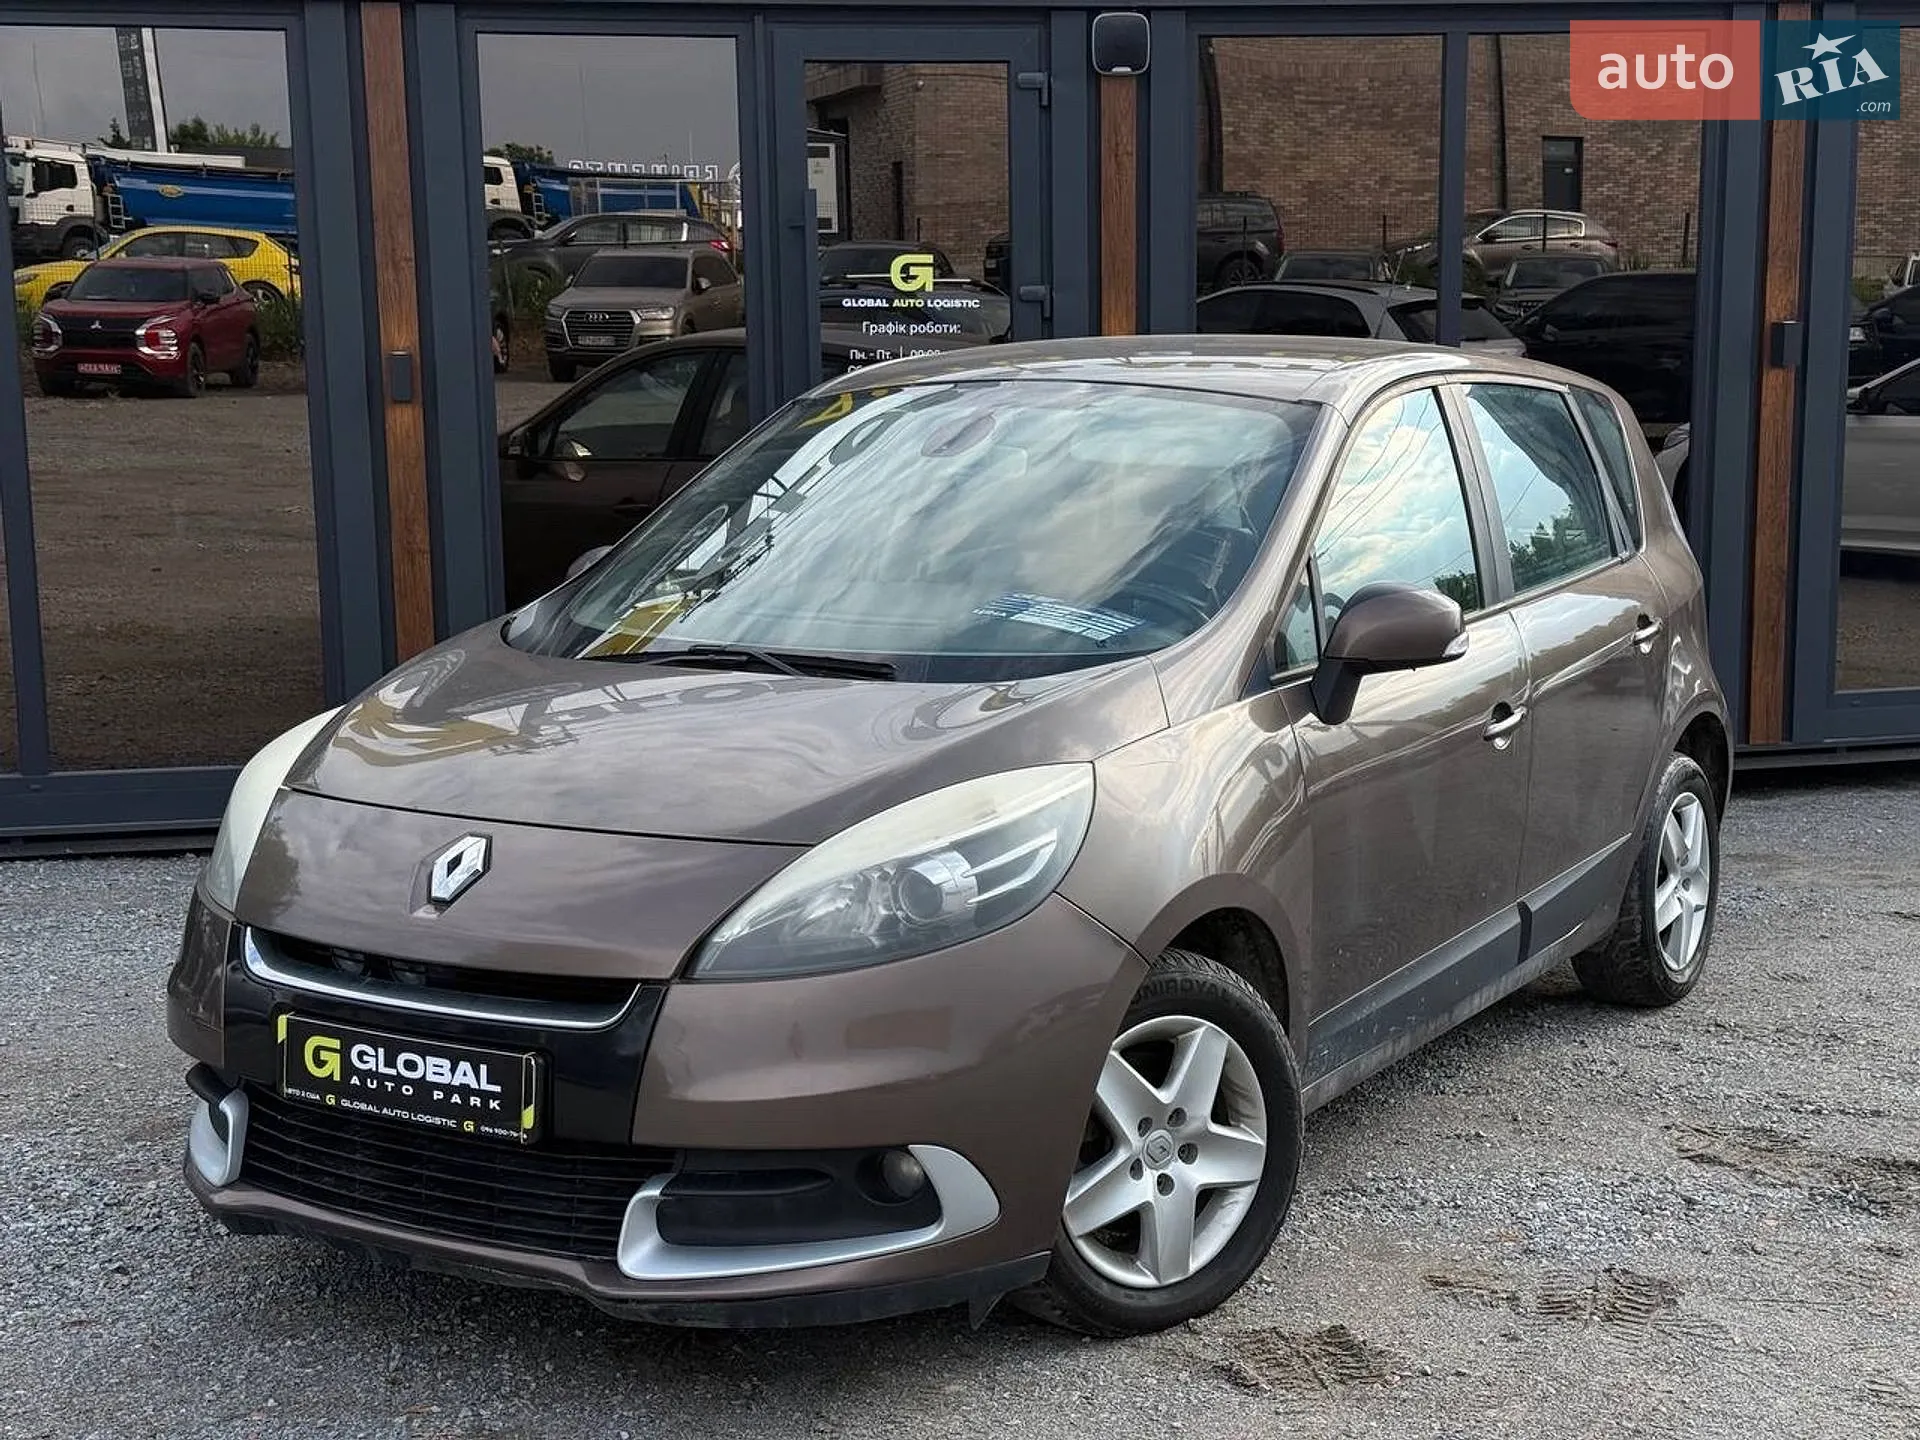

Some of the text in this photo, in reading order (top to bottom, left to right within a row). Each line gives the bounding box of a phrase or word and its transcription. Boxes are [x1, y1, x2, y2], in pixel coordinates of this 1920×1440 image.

[842, 298, 981, 309] GLOBAL AUTO LOGISTIC
[862, 320, 962, 336] Графік роботи:
[350, 1043, 502, 1092] GLOBAL
[349, 1075, 502, 1111] AUTO PARK
[340, 1098, 380, 1114] GLOBAL
[381, 1106, 410, 1120] AUTO
[410, 1112, 458, 1129] LOGISTIC
